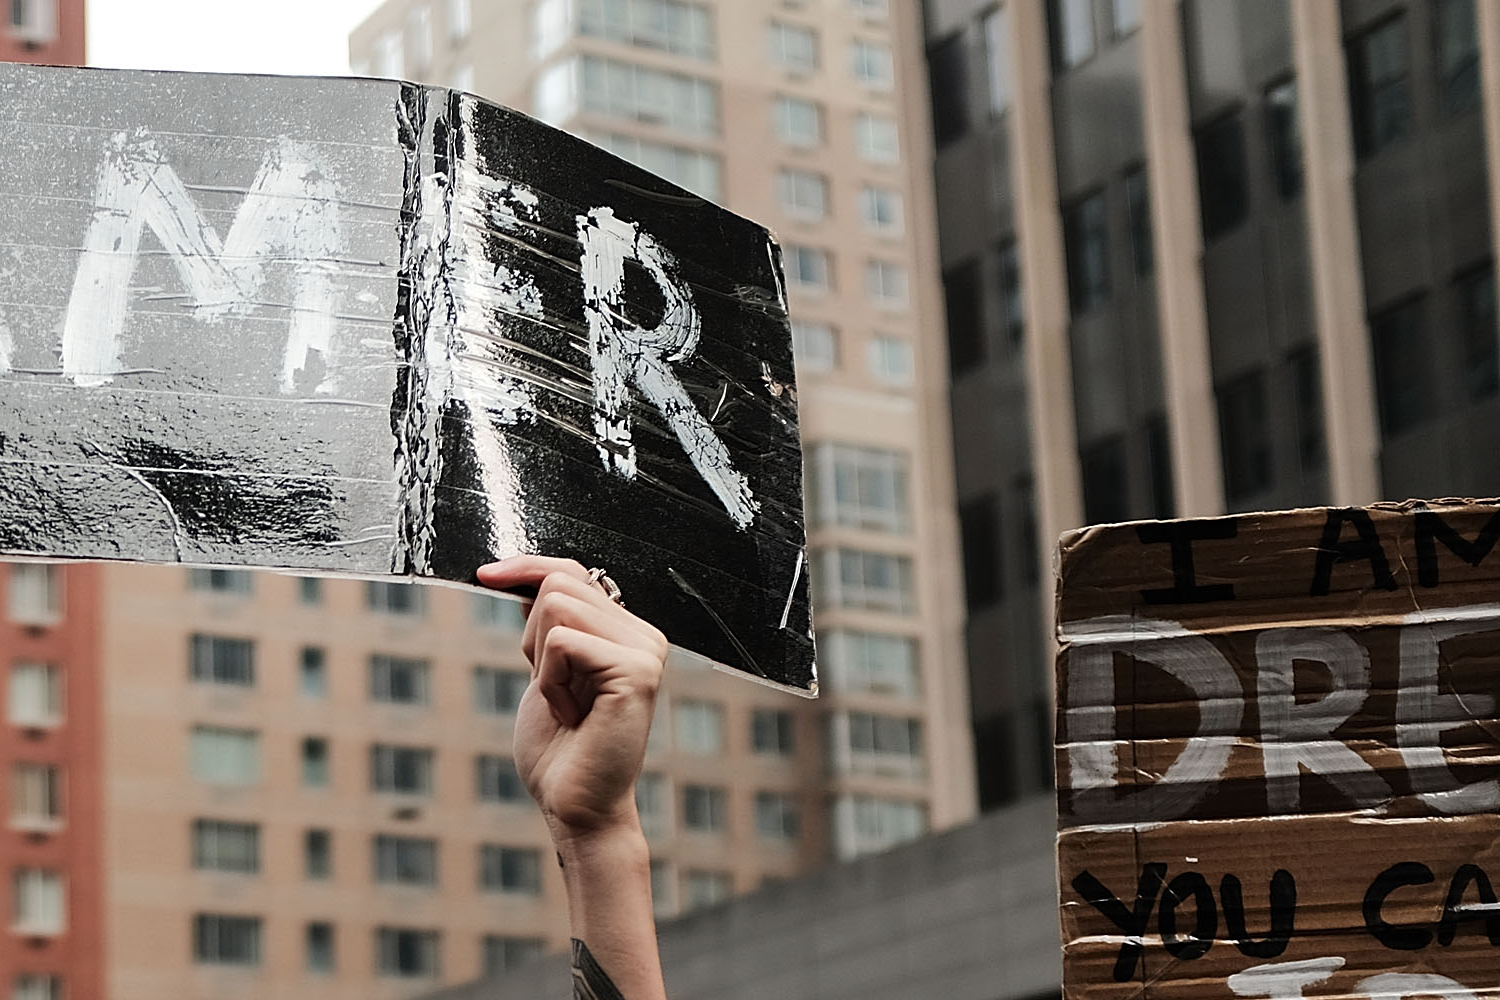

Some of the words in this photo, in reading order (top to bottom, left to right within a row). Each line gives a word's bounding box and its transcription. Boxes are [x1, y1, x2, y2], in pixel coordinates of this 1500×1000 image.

[1135, 517, 1239, 602] I
[1311, 507, 1500, 597] AM
[1071, 863, 1297, 982] YOU
